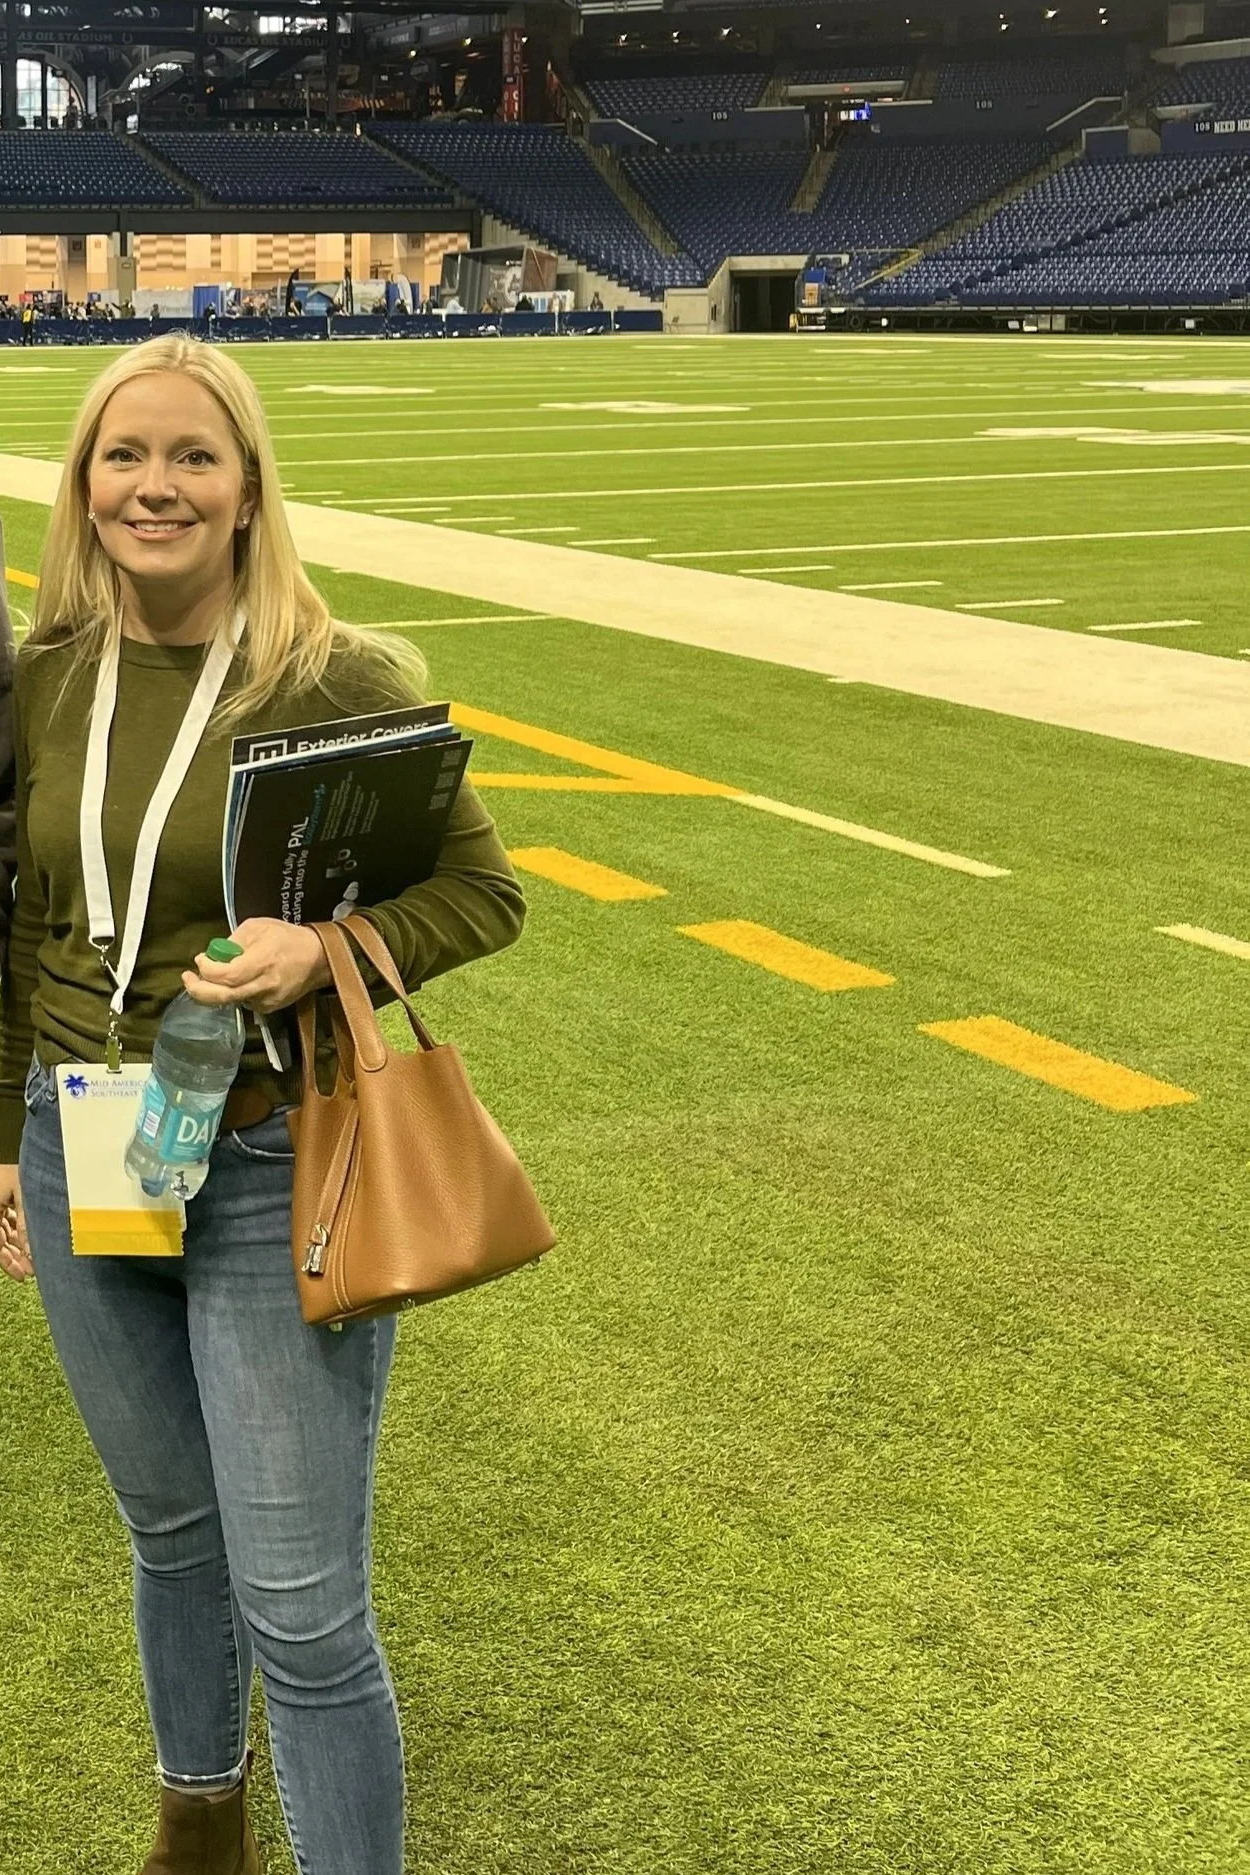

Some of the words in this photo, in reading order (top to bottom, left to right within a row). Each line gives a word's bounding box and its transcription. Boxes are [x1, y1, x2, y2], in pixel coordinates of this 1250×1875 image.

[1214, 120, 1235, 133] NEED
[297, 733, 367, 753] Exterior
[288, 816, 309, 849] PAL
[283, 853, 297, 875] fully
[297, 849, 309, 867] the
[281, 876, 293, 890] by
[295, 868, 305, 890] into
